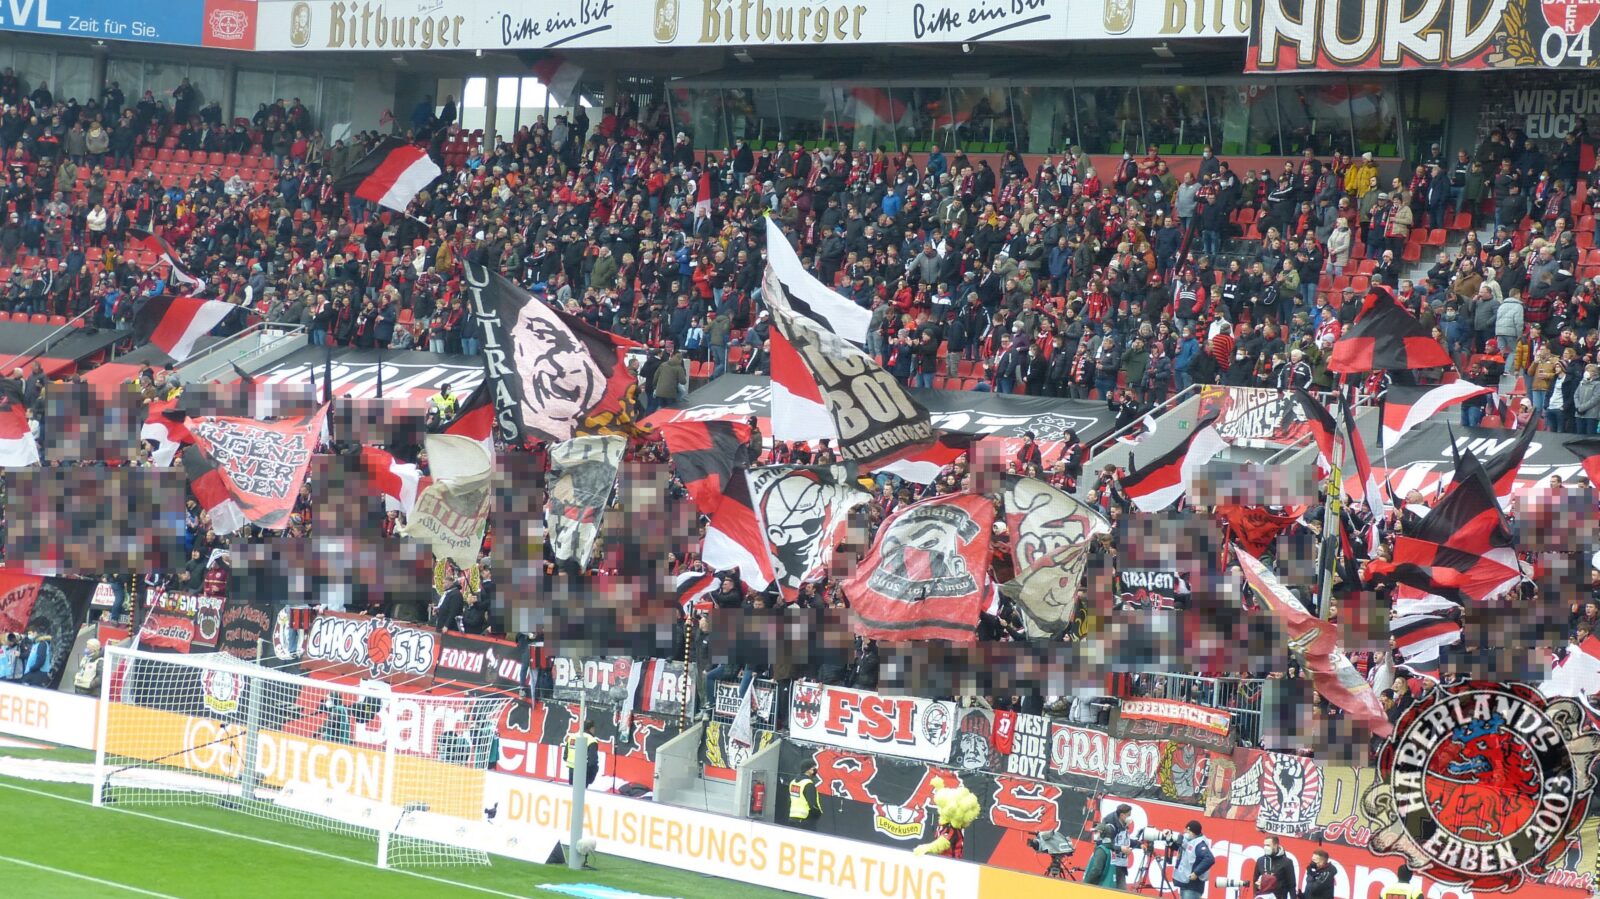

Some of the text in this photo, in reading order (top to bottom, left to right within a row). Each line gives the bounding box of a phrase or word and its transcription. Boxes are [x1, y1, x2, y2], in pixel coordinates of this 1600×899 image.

[0, 0, 61, 29] VL
[68, 16, 160, 38] Zeit für Sie.
[326, 0, 465, 49] Bitburger
[502, 0, 614, 46] Bitte ein Bit
[698, 0, 868, 43] Bitburger
[913, 3, 962, 39] Bitte
[967, 7, 1006, 24] ein
[1540, 25, 1592, 67] 04
[1514, 83, 1600, 114] WIR FÜR
[463, 258, 520, 442] ULTRAS
[307, 616, 368, 665] CHAOS
[392, 631, 435, 674] 513
[440, 648, 484, 673] FORZA
[718, 686, 740, 698] STA
[718, 697, 743, 707] VERBO
[0, 694, 49, 729] ERER
[824, 689, 917, 746] FSI
[1012, 732, 1047, 759] SIDE
[255, 733, 379, 801] DITCON
[1007, 752, 1047, 780] BOYZ
[507, 787, 946, 899] DIGITALISIERUNGS BERATUNG
[879, 818, 919, 835] Leverkusen
